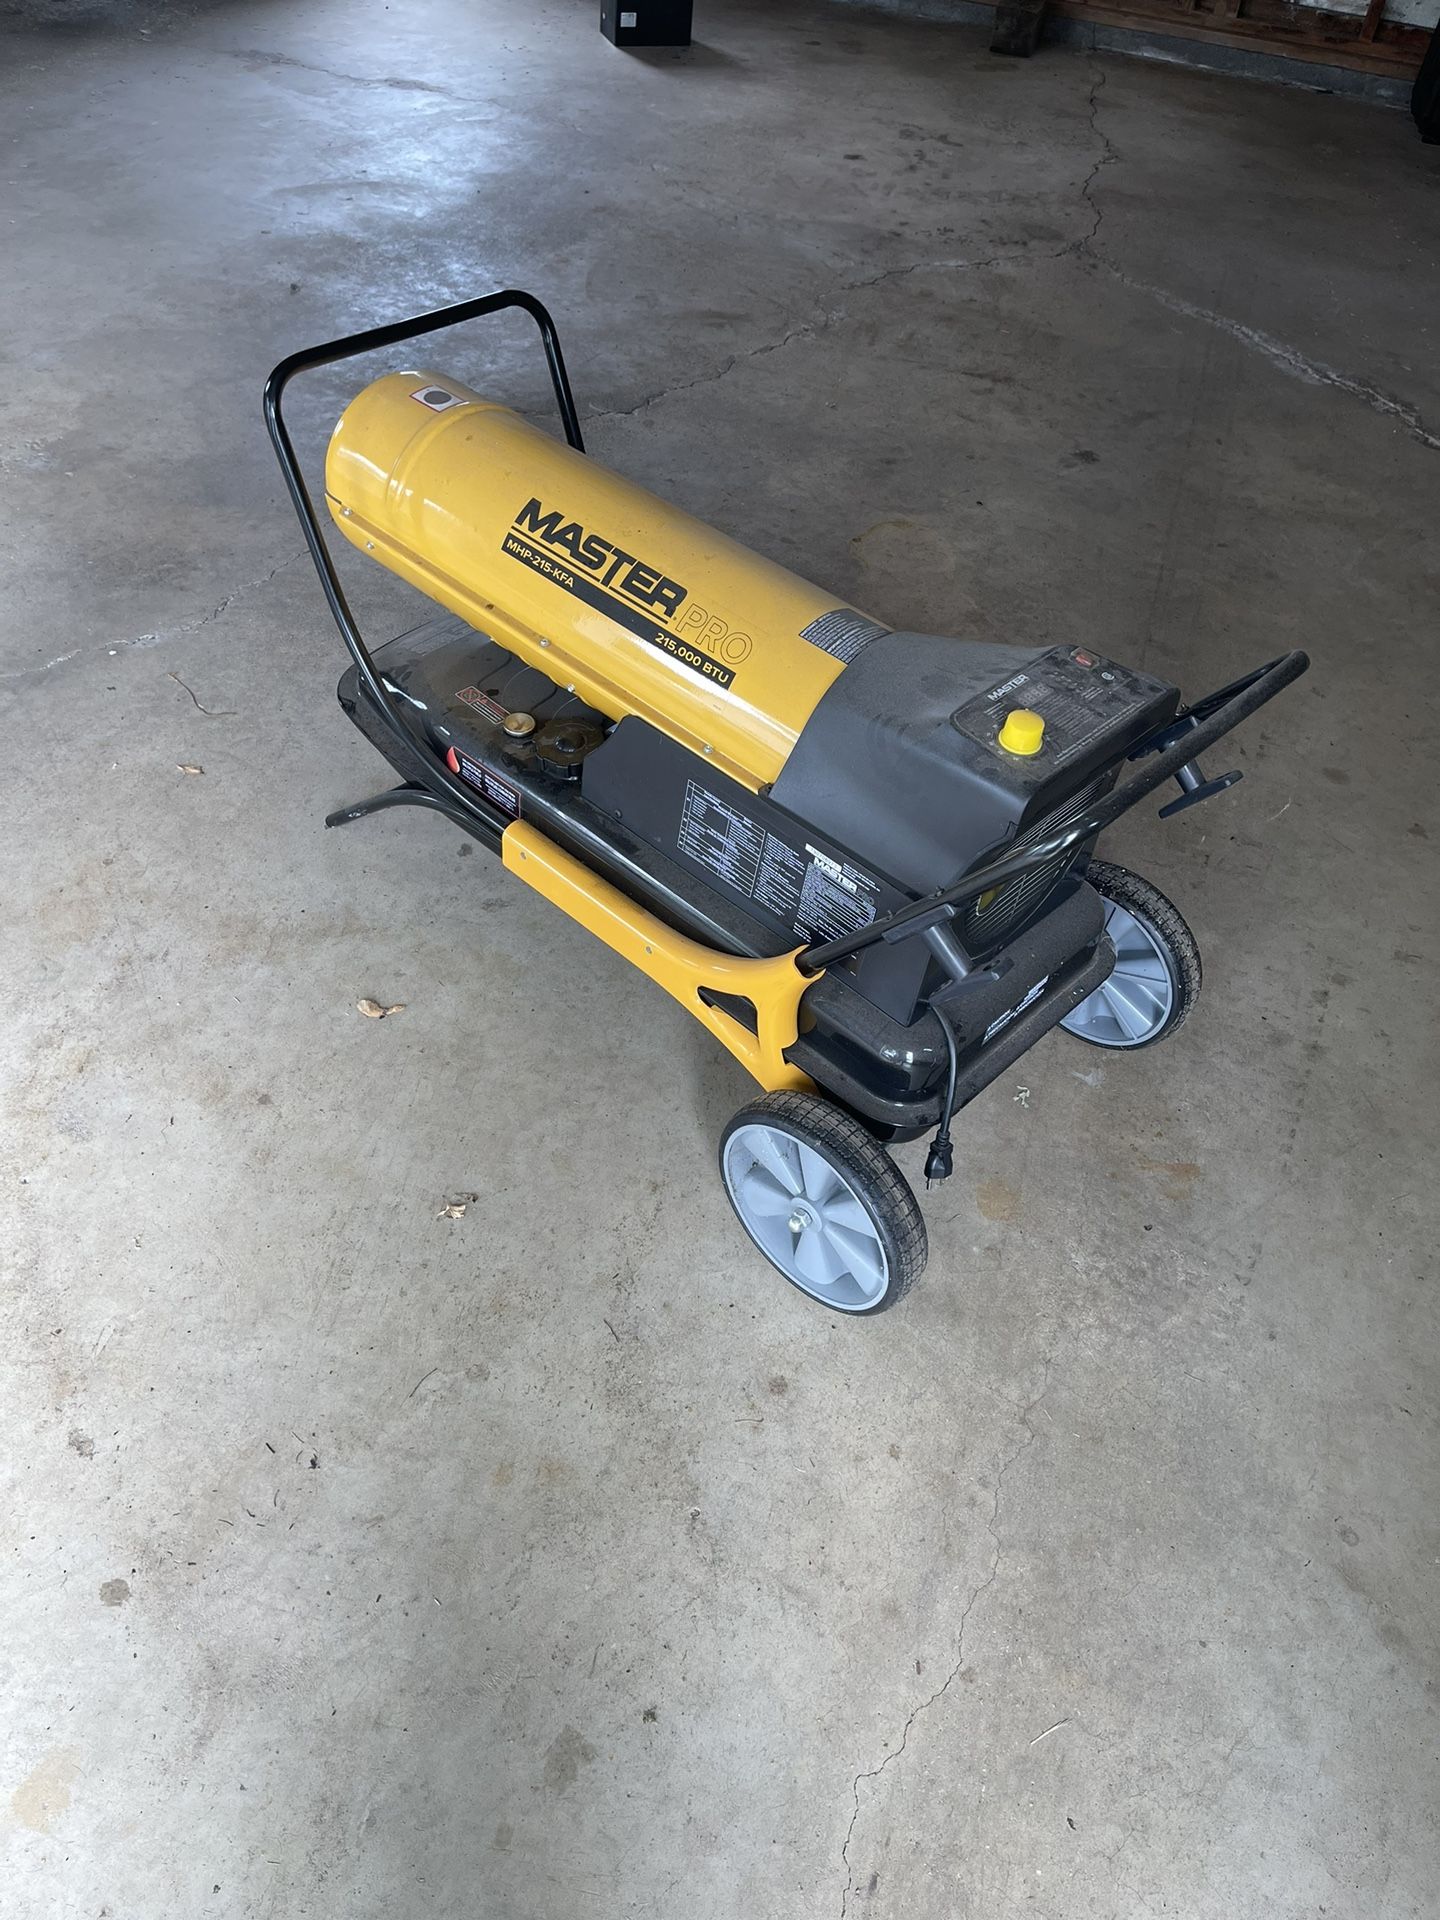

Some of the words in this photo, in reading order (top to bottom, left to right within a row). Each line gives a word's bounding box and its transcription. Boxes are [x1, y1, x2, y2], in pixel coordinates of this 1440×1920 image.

[506, 538, 575, 588] MHP-215-KFA
[655, 632, 702, 667] 215,000
[702, 661, 729, 684] BTU
[514, 497, 688, 618] MASTER
[675, 603, 753, 665] PRO
[987, 674, 1030, 701] MASTER
[813, 856, 858, 893] MASTER
